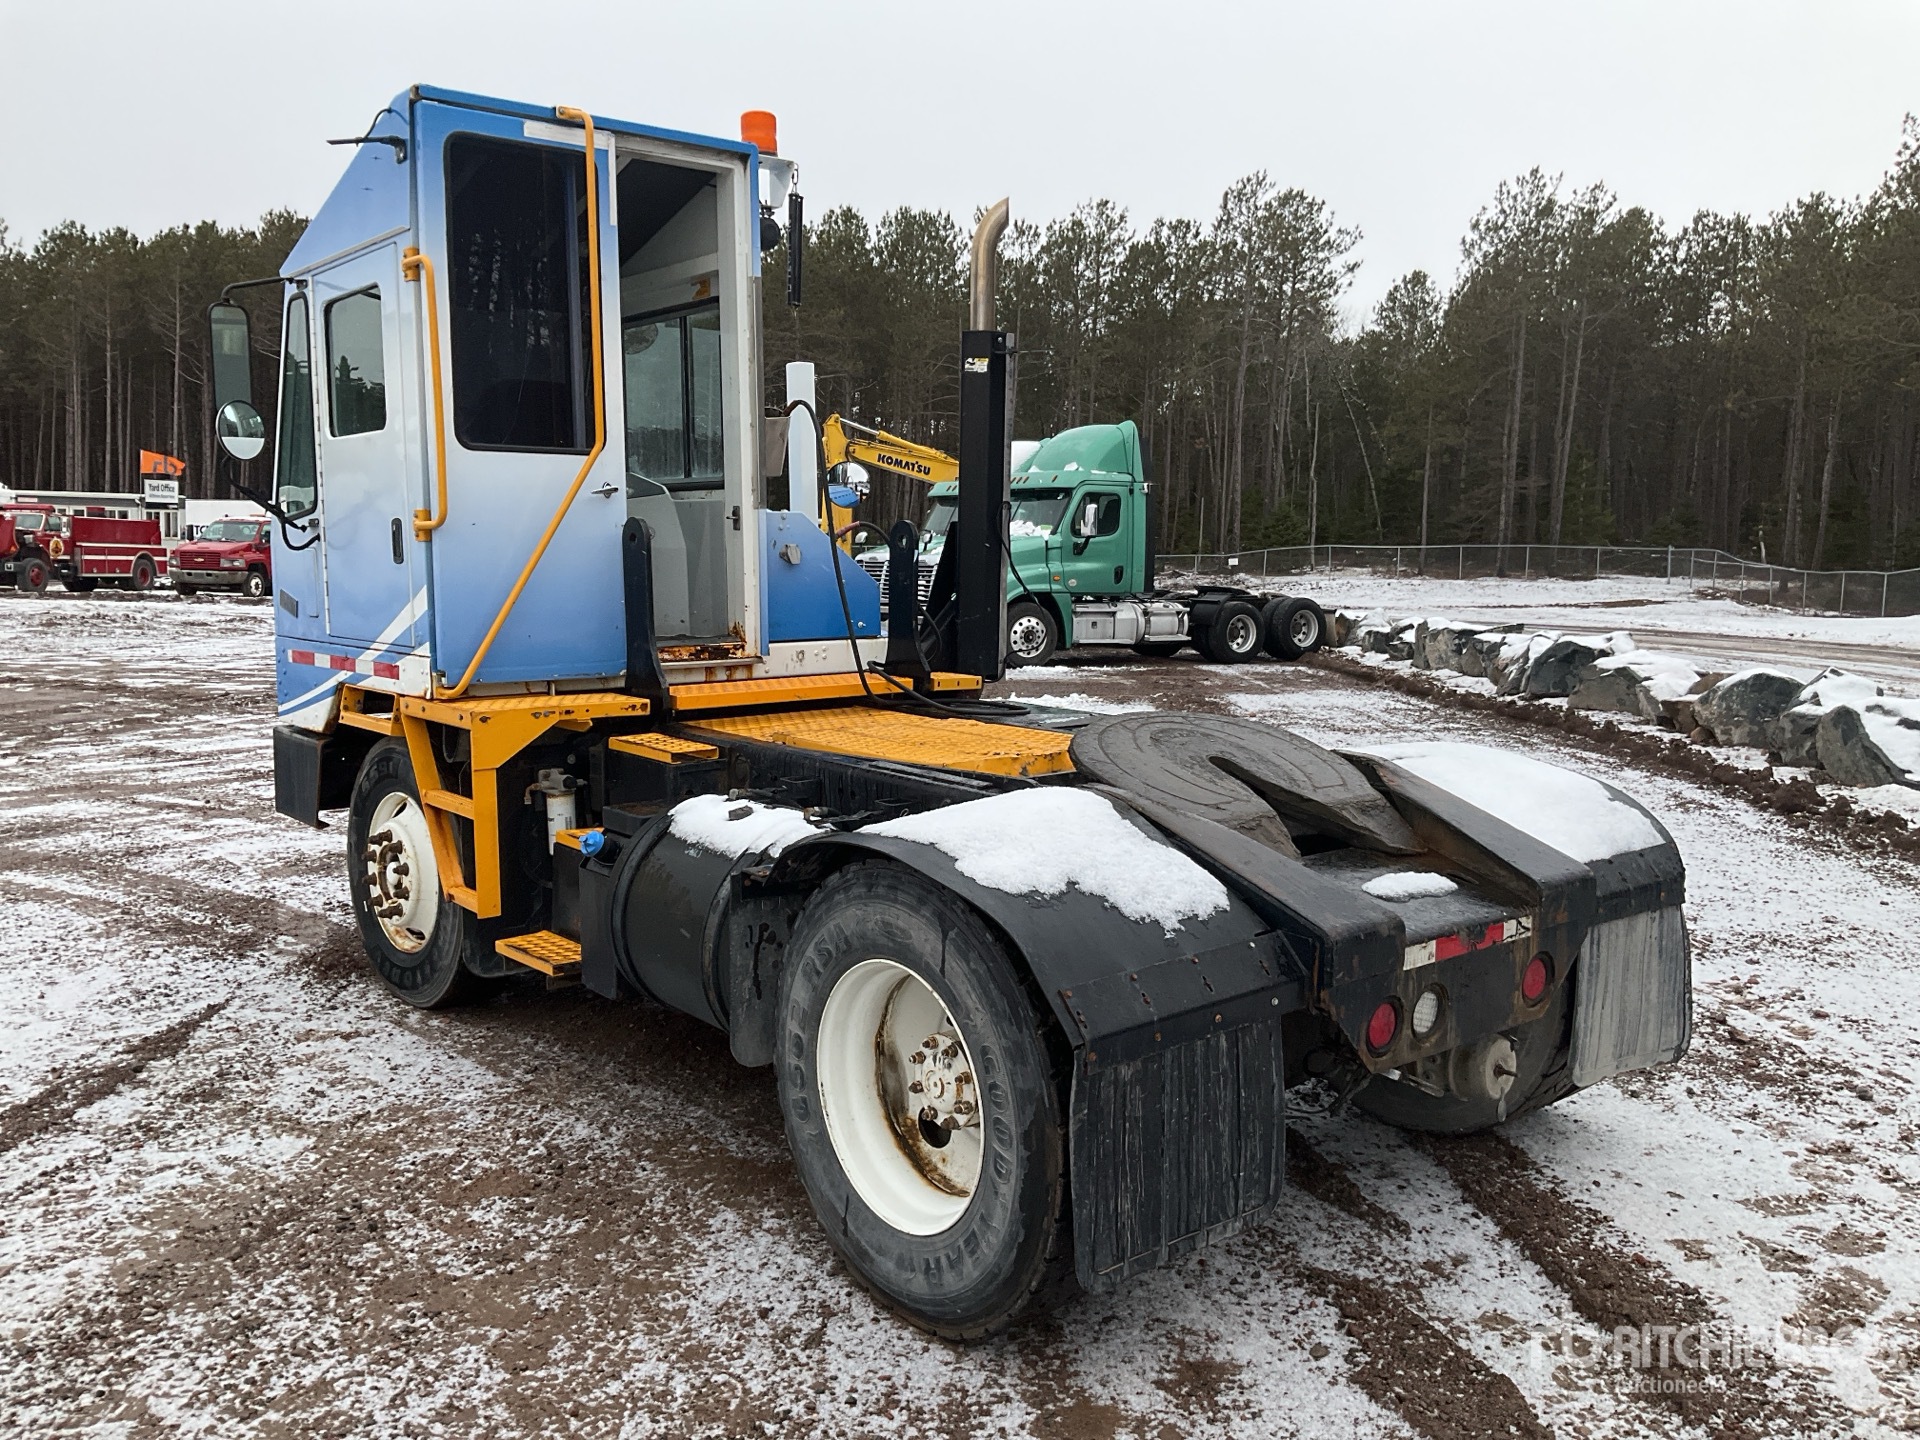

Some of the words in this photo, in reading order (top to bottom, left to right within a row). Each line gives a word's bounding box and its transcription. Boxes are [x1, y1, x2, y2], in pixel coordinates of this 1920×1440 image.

[877, 453, 931, 475] KOMATSU
[148, 483, 160, 492] Yard
[160, 484, 175, 493] Office
